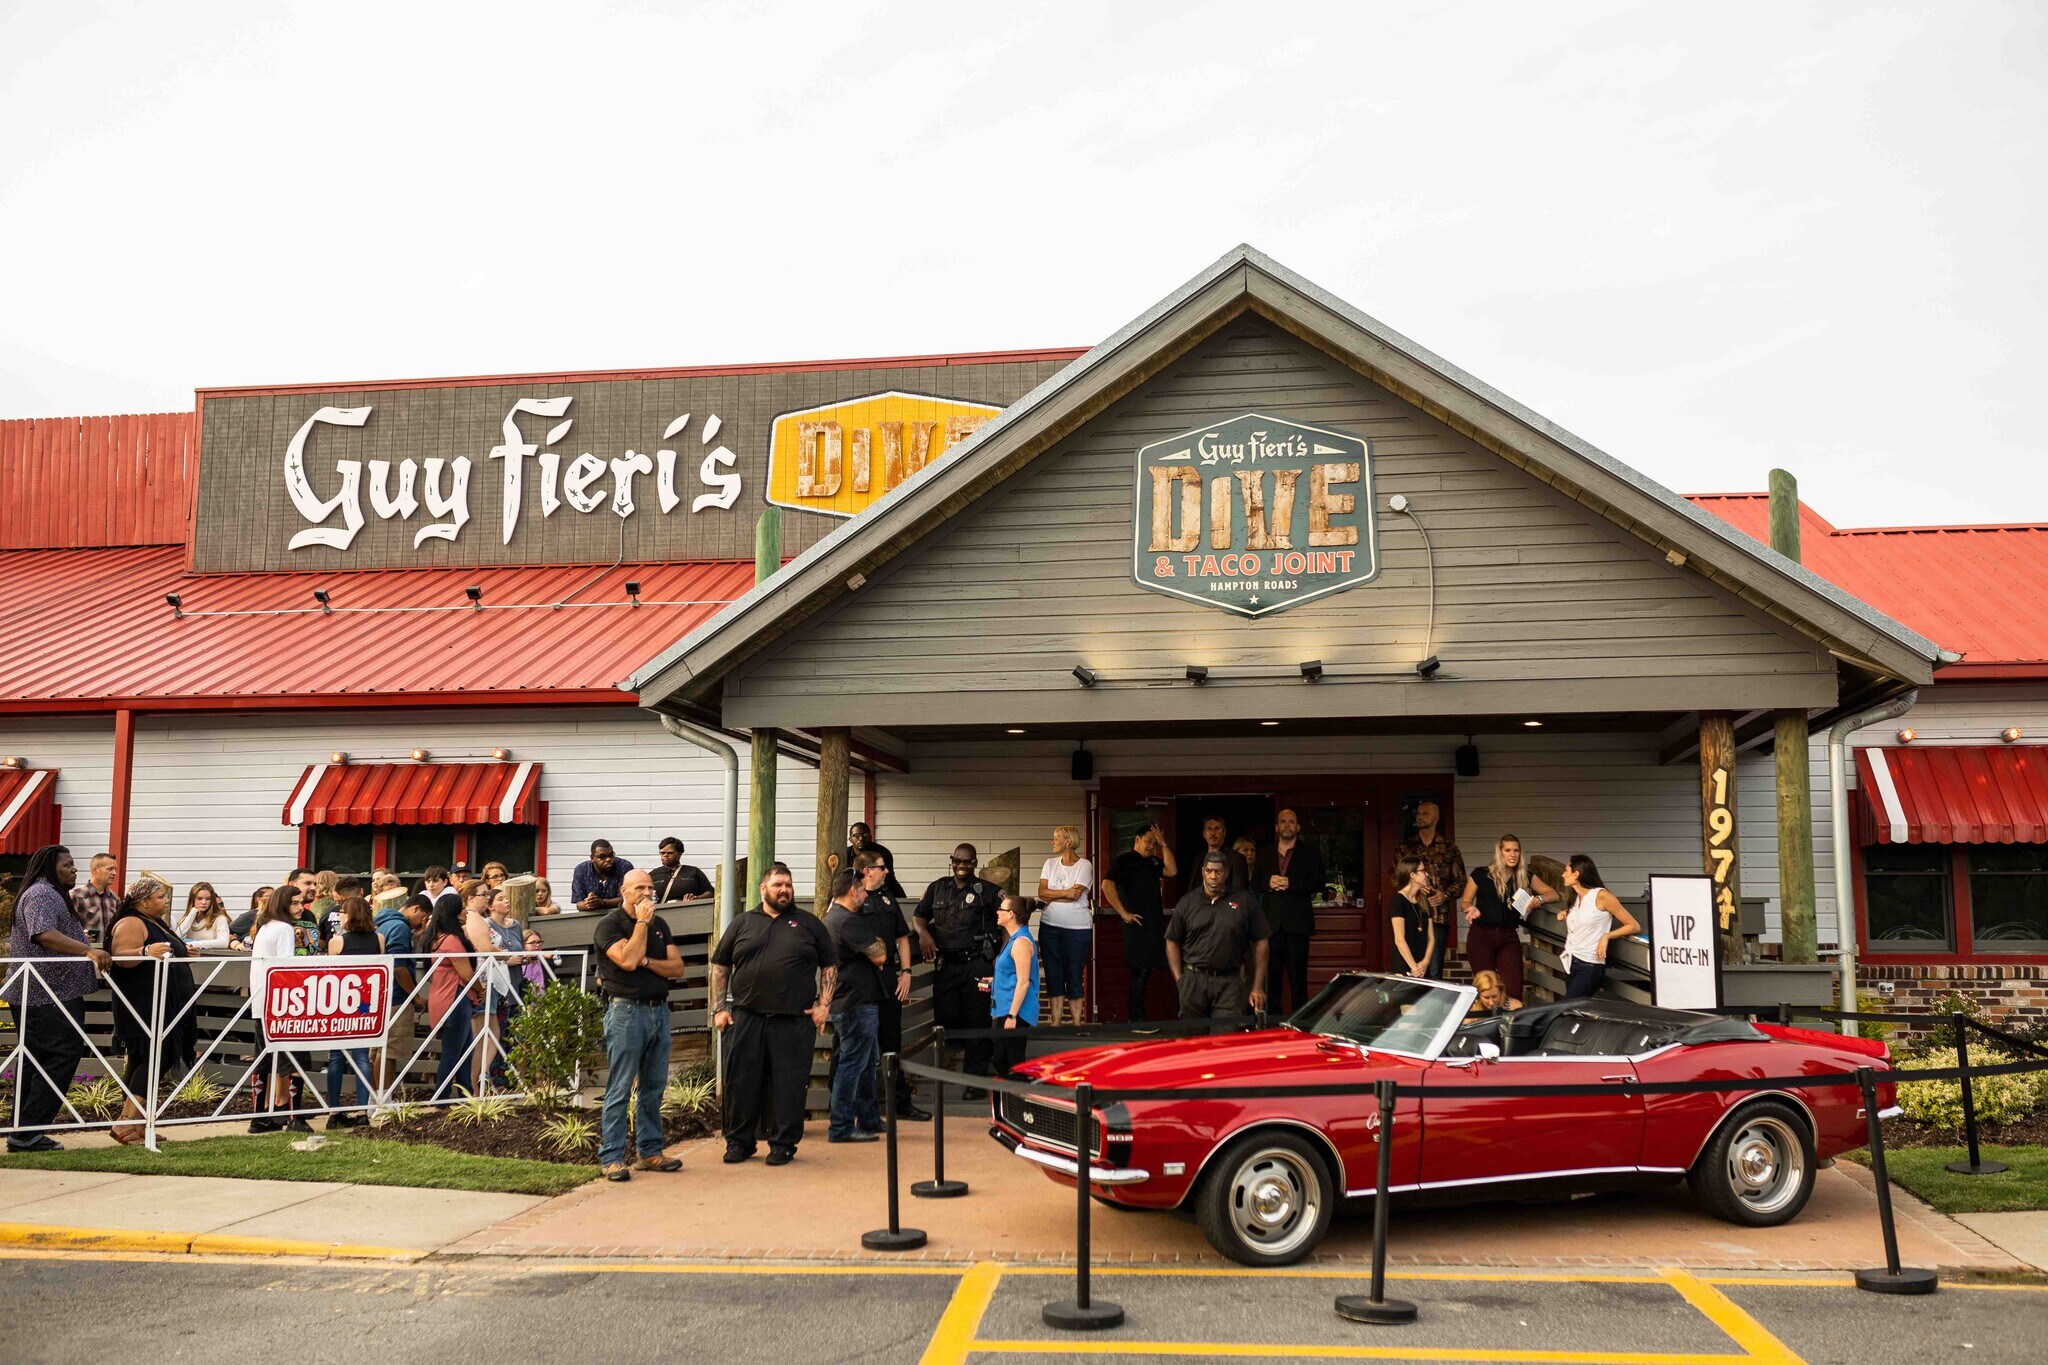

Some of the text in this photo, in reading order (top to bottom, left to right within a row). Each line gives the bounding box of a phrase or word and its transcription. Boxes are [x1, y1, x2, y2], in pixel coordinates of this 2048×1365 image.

[1198, 433, 1244, 466] Guy
[284, 406, 472, 550] Guy
[1147, 463, 1361, 552] DIVE
[1154, 551, 1355, 577] & TACO JOINT
[1210, 580, 1298, 591] HAMPTON ROADS
[1708, 768, 1736, 930] 1974
[1670, 914, 1695, 940] VIP
[1660, 946, 1709, 966] CHECK-IN
[269, 1016, 378, 1034] AMERICA'S COUNTRY
